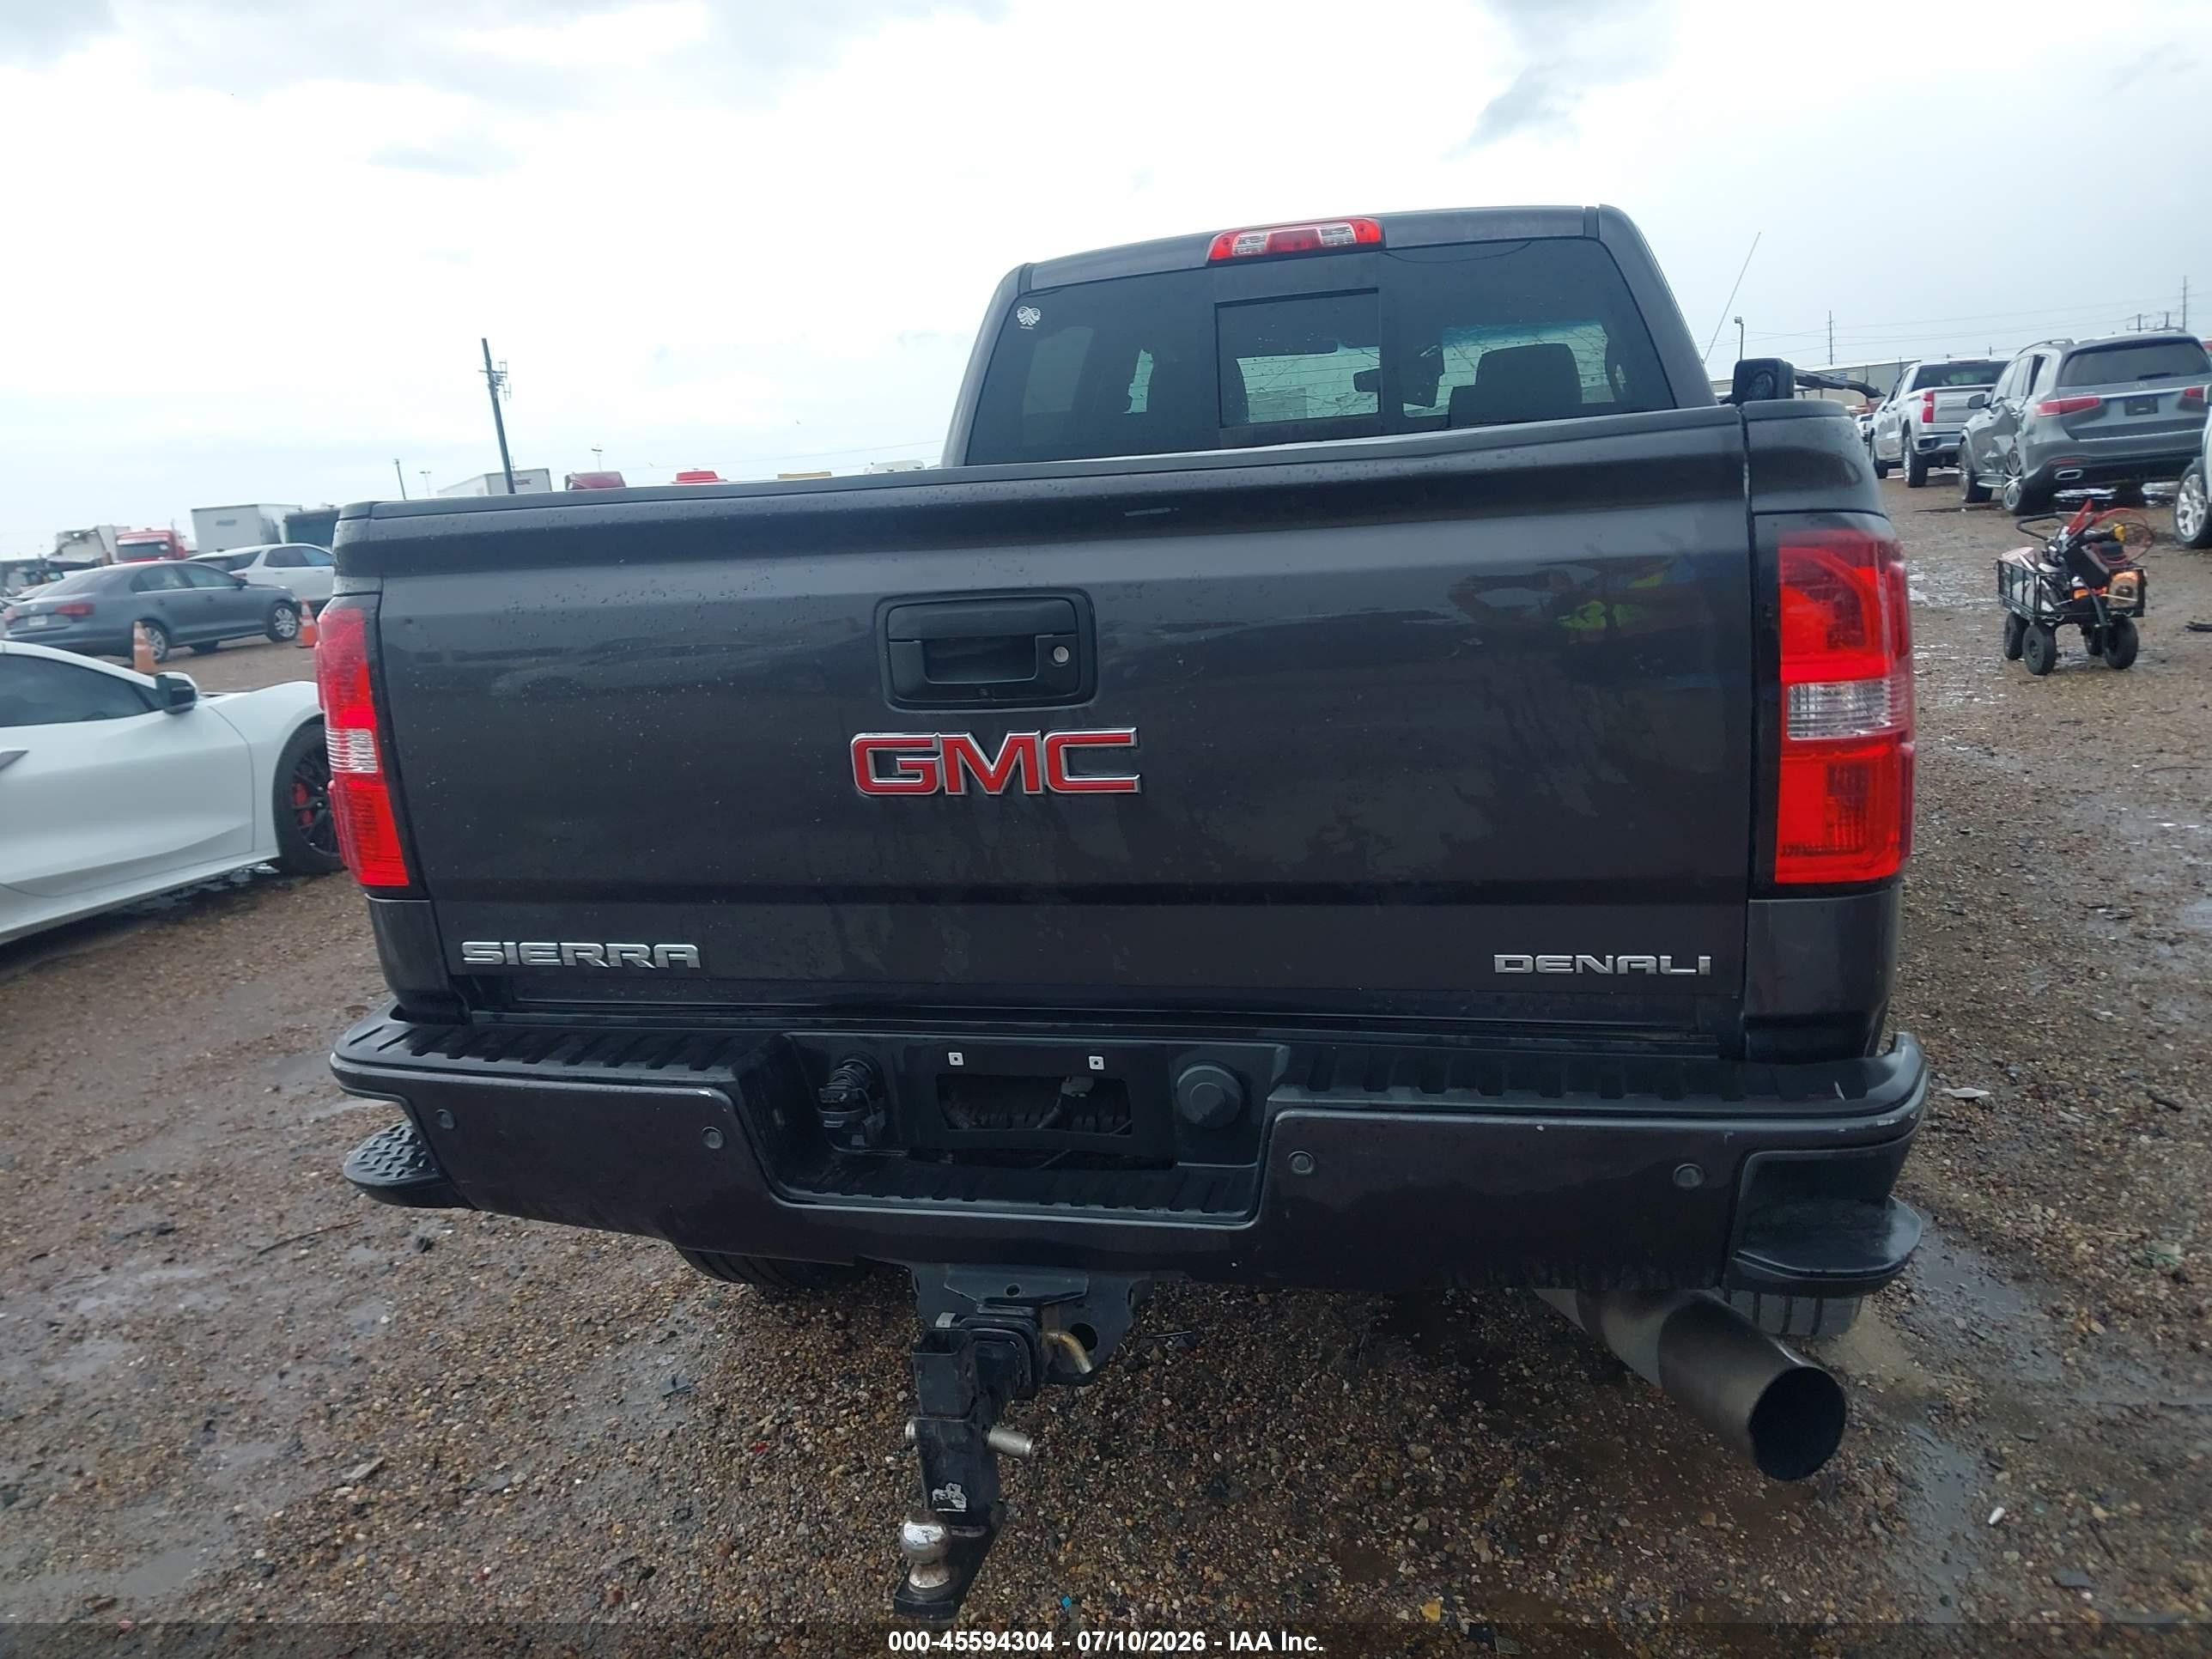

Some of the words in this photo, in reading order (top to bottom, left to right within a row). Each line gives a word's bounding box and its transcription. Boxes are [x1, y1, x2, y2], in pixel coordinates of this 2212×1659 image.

[850, 727, 1140, 796] GMC
[461, 941, 702, 969] SIERRA
[1493, 954, 1712, 975] DENALI
